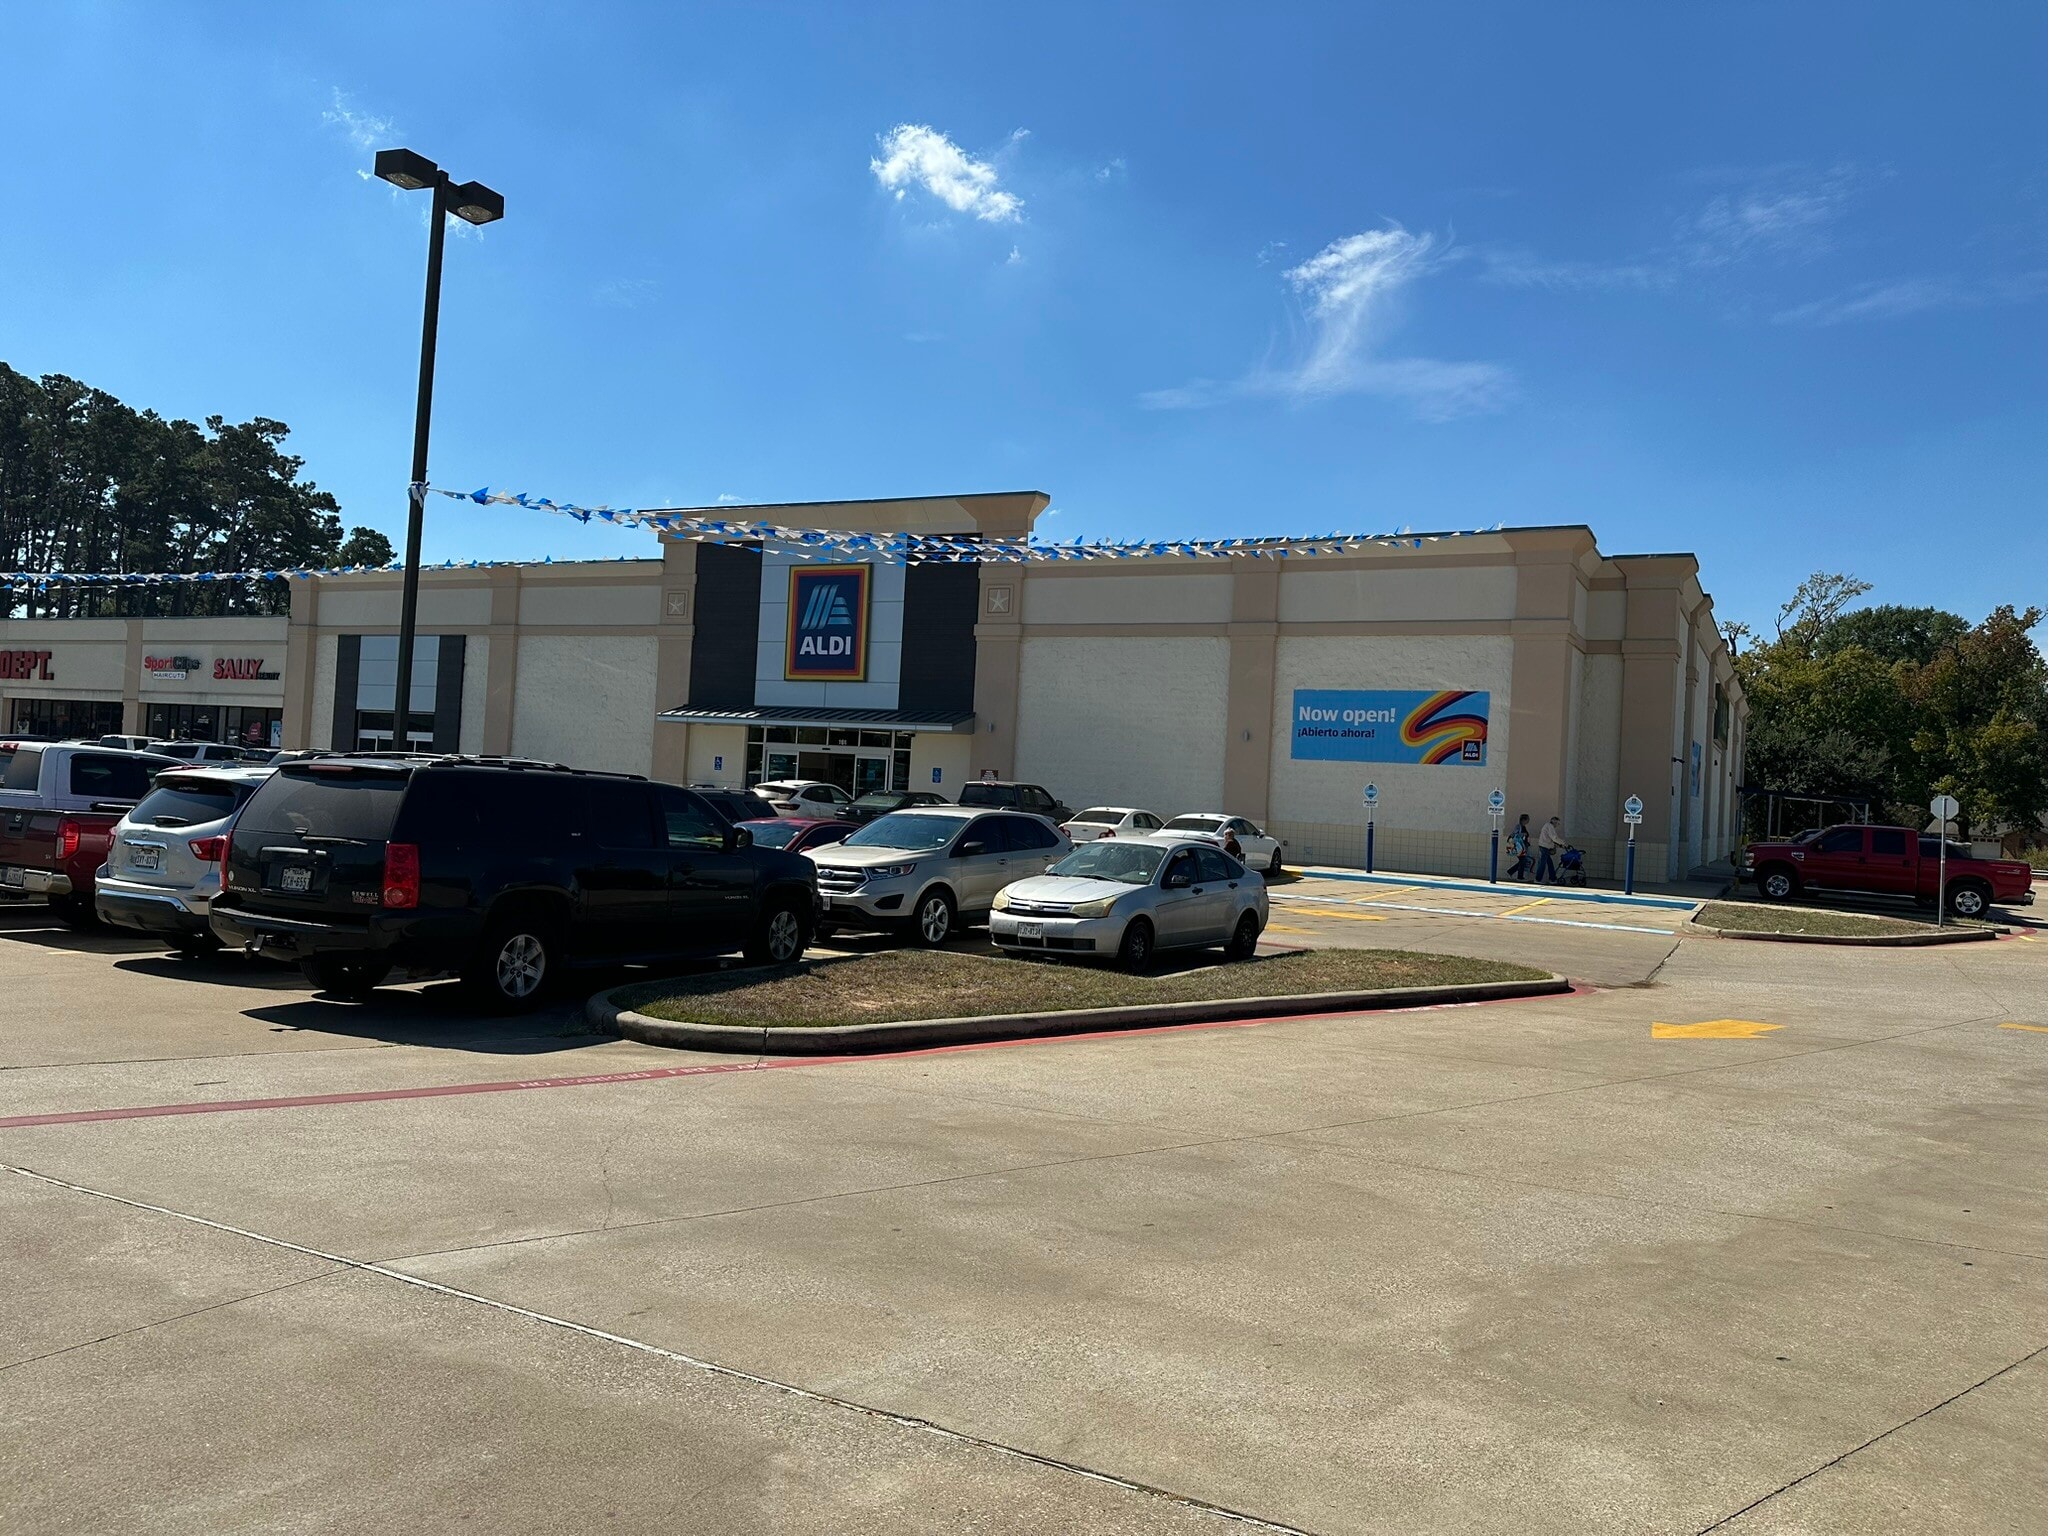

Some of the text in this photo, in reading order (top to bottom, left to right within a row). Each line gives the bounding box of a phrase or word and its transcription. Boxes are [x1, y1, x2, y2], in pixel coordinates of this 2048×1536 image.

[799, 636, 851, 655] ALDI
[0, 650, 54, 680] DEPT.
[213, 658, 264, 679] SALLY
[1299, 706, 1395, 726] Now open!
[1297, 727, 1375, 738] ¡Abierto ahora!
[560, 1072, 651, 1085] PARKING
[667, 1066, 715, 1075] FIRE
[721, 1062, 770, 1072] LANE
